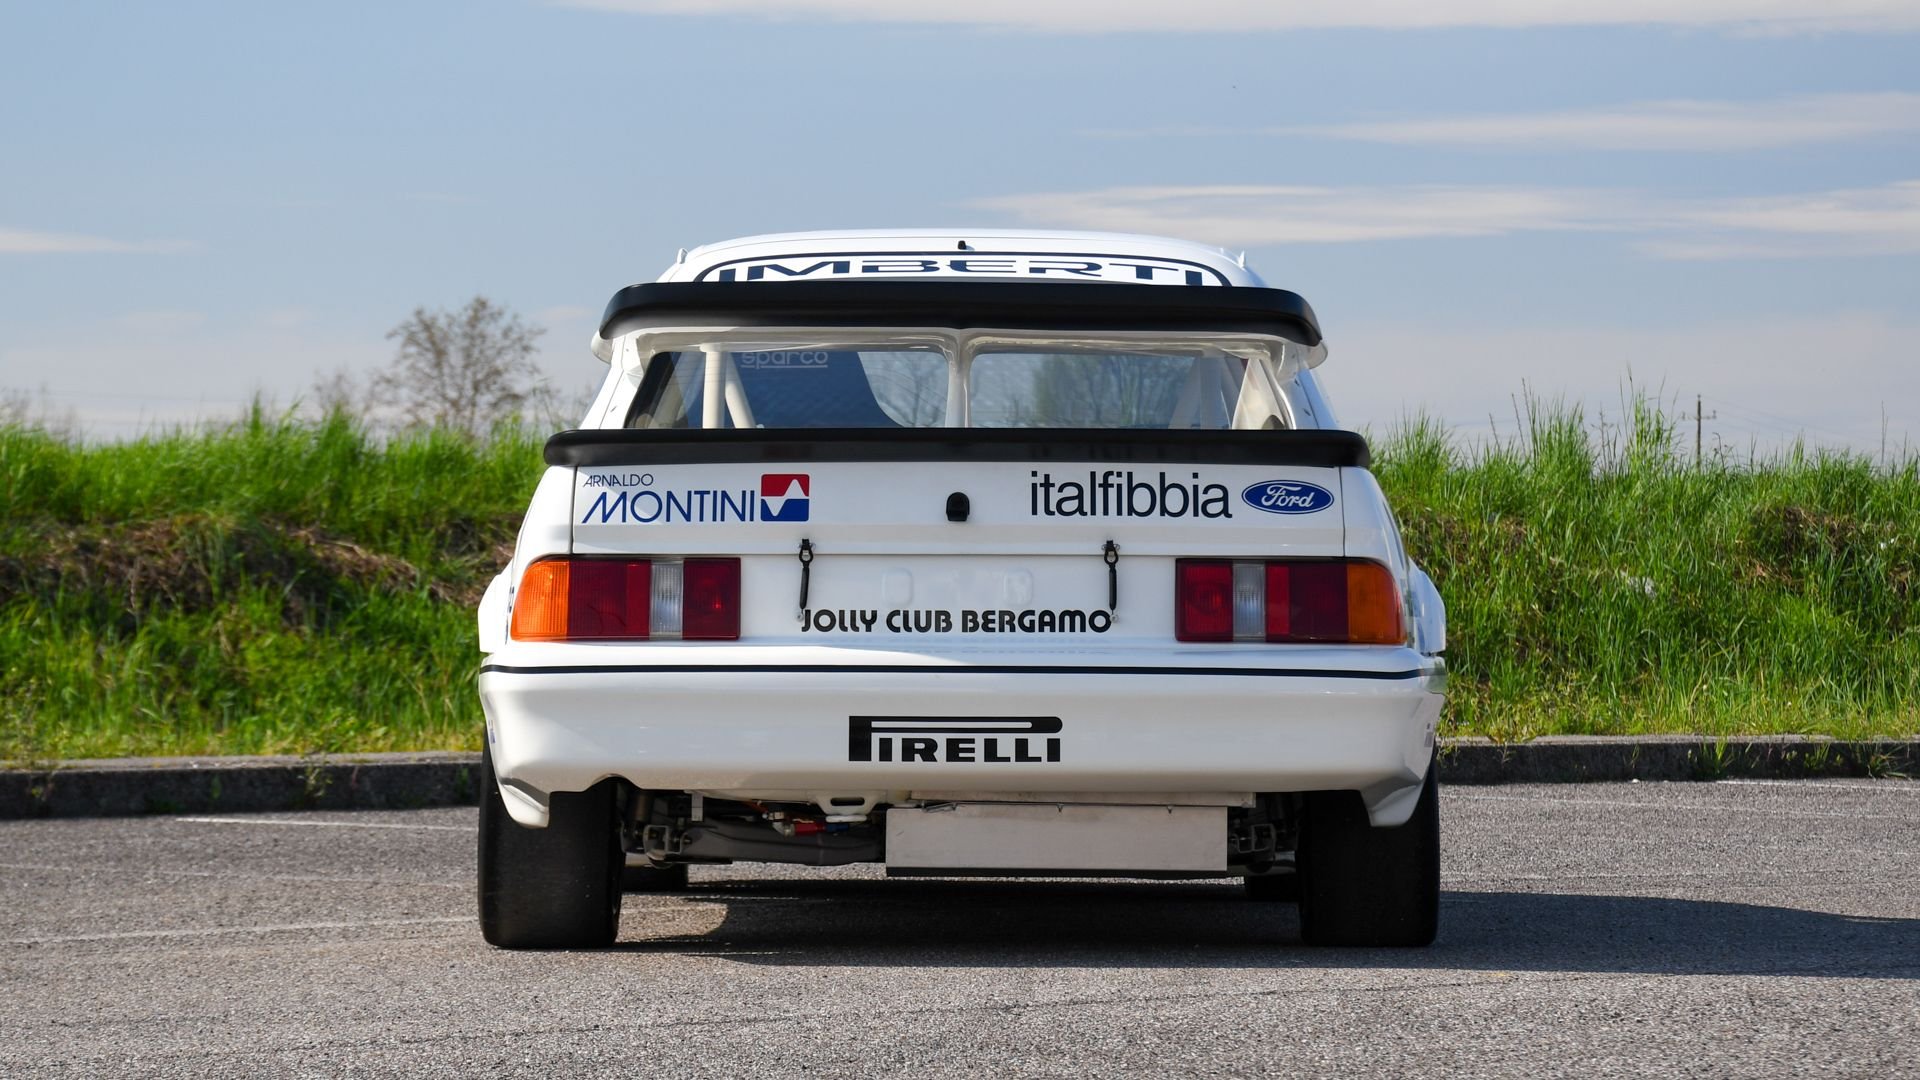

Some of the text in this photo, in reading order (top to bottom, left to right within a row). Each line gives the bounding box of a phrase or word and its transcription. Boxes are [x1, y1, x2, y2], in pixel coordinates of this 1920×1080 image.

[719, 260, 1203, 286] IMBERTI
[741, 350, 829, 369] sparco
[583, 473, 654, 487] ARNALDO
[582, 490, 755, 523] MONTINI
[1031, 470, 1232, 518] italfibbia
[1261, 486, 1314, 508] Ford
[801, 609, 1112, 633] JOLLY CLUB BERGAMO
[848, 715, 1063, 762] PIRELLI
